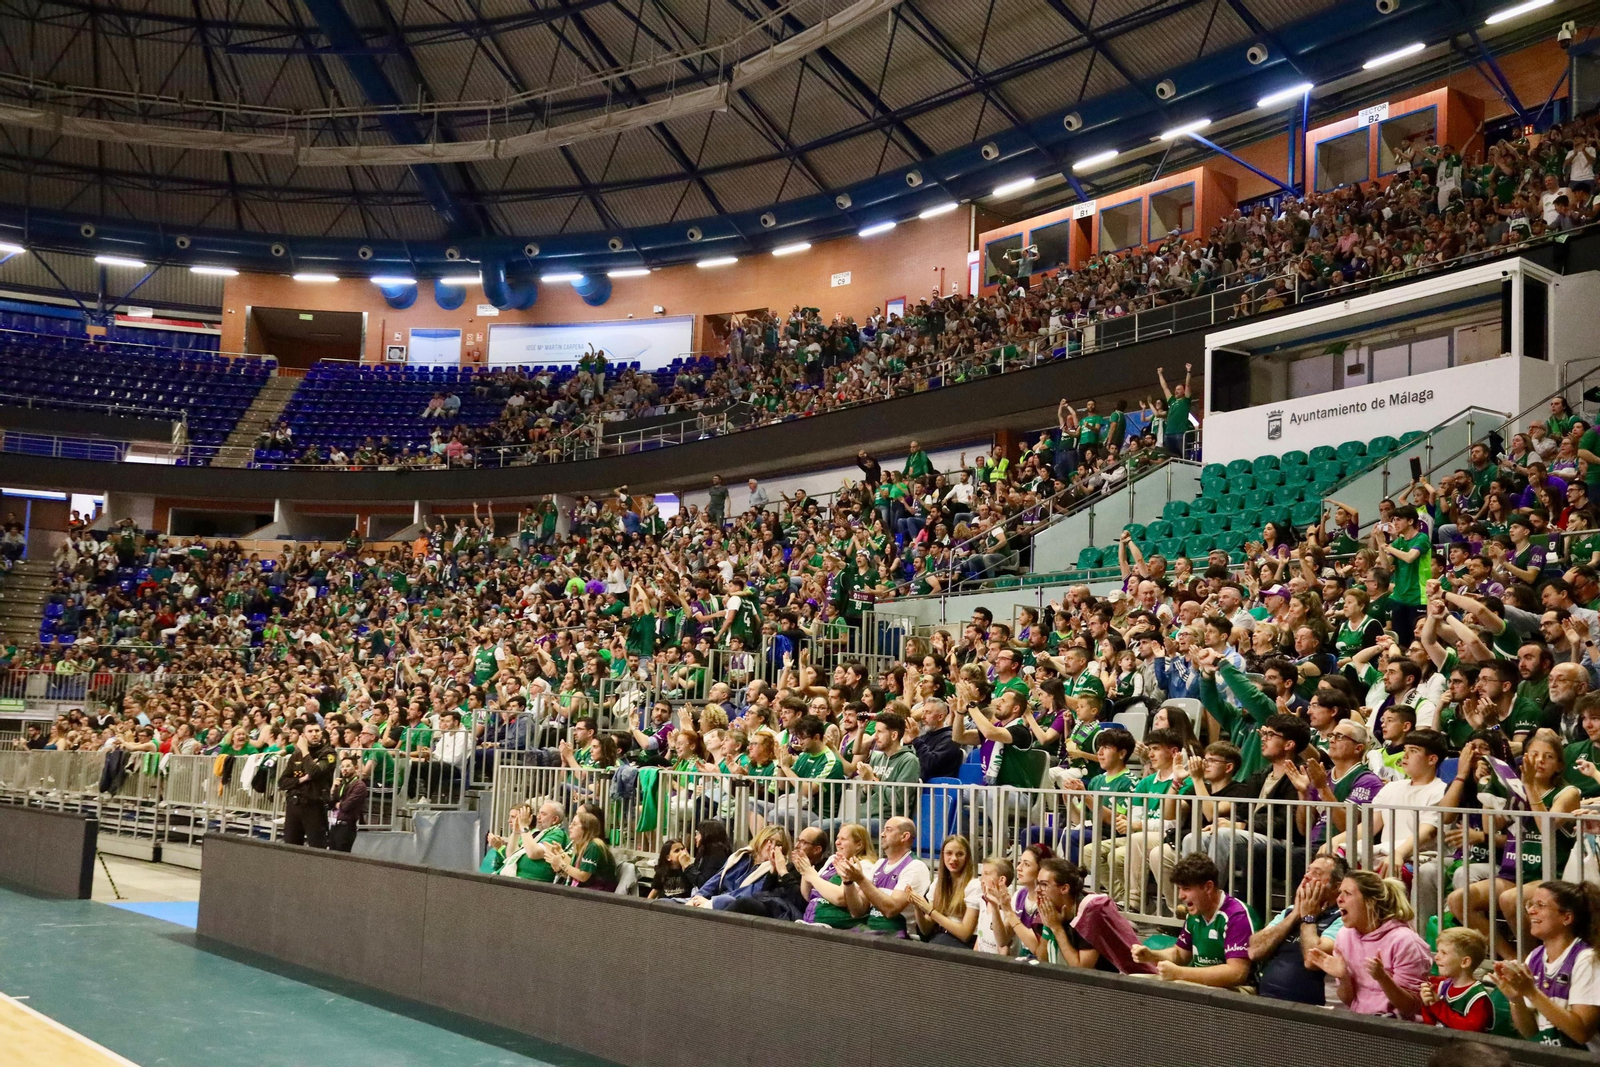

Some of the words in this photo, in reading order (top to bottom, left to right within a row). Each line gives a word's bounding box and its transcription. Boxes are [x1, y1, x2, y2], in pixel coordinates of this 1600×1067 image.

[1361, 103, 1387, 117] SECTOR
[1368, 113, 1380, 123] B2
[1289, 402, 1367, 426] Ayuntamiento
[1370, 397, 1386, 410] de
[1389, 388, 1434, 407] Málaga
[743, 611, 751, 627] 4
[1506, 851, 1541, 864] maga
